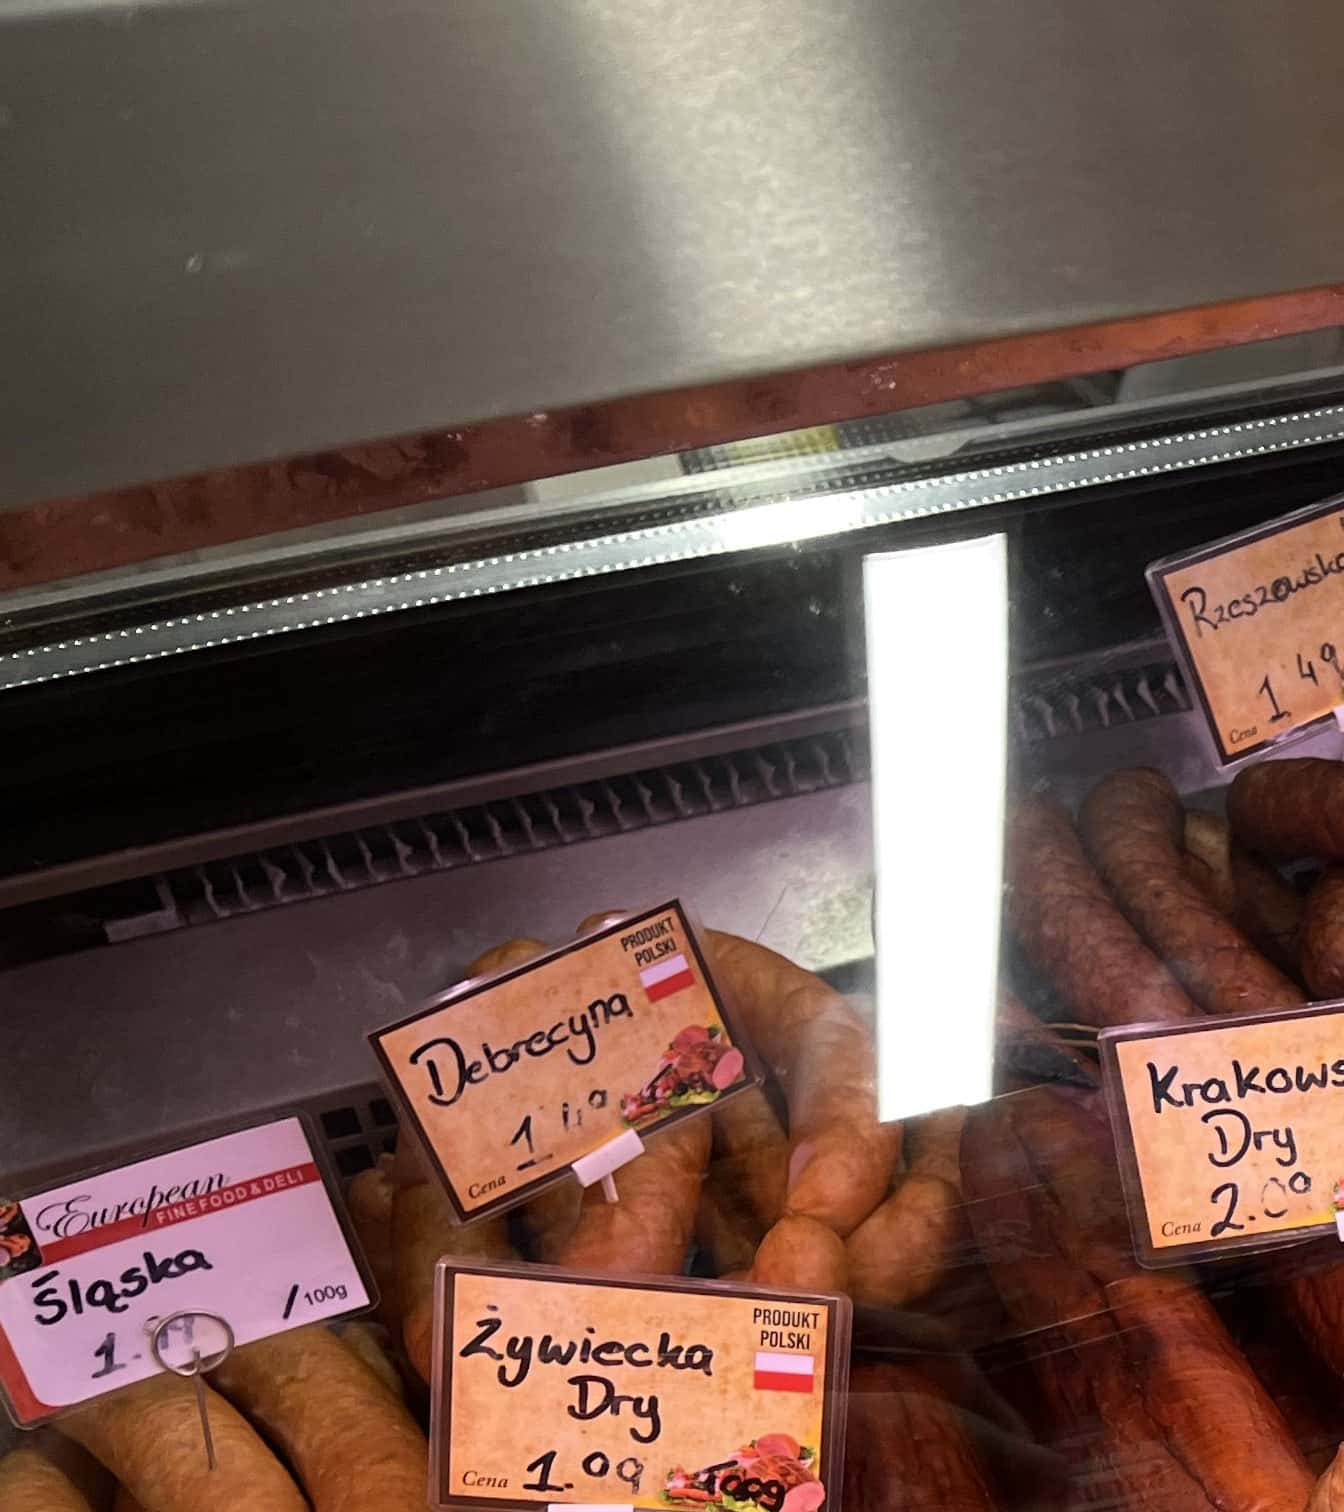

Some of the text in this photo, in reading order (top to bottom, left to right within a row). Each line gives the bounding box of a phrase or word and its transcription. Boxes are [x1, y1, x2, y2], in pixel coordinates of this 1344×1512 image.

[621, 916, 675, 951] PRODUKT
[635, 938, 677, 966] POLSKI
[409, 993, 634, 1106] Debrecyna
[1201, 1108, 1298, 1167] Dry
[35, 1173, 230, 1239] European
[155, 1170, 304, 1225] FINE FOOD & DELI
[468, 1175, 506, 1200] Cena
[1161, 1220, 1202, 1237] Cena
[31, 1249, 213, 1326] Śląska
[752, 1307, 819, 1330] PRODUKT
[760, 1330, 811, 1350] POLSKI
[459, 1304, 713, 1387] Żywiecka
[567, 1375, 662, 1444] Dry
[461, 1469, 509, 1490] Cena
